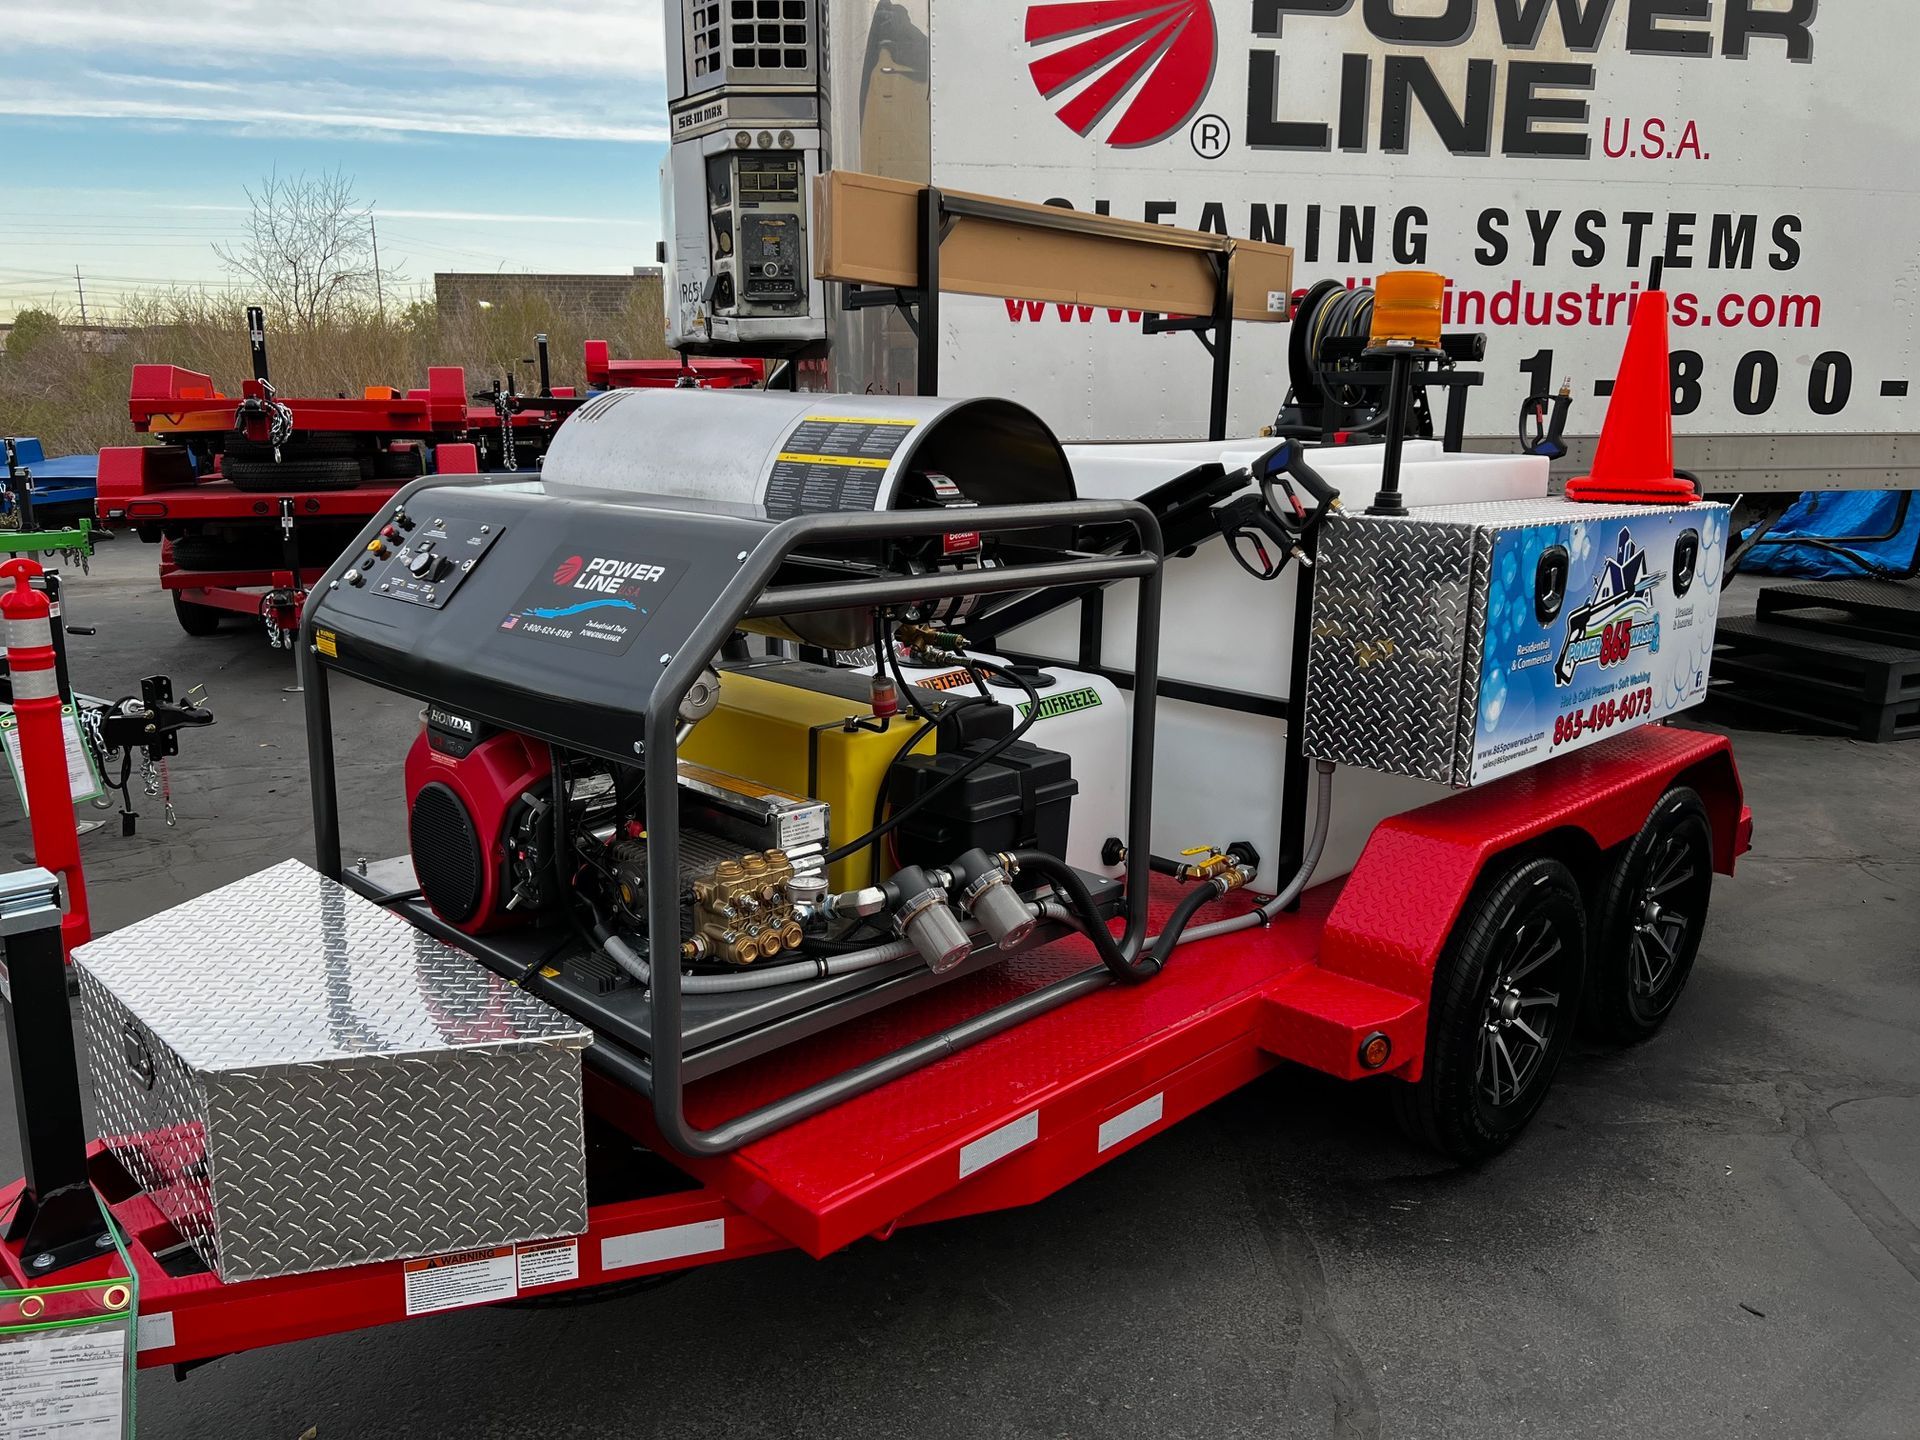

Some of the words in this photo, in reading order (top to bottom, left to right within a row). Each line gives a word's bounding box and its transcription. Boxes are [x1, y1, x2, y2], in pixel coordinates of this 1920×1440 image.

[704, 104, 722, 121] MAX
[1245, 49, 1594, 159] LINE
[1602, 117, 1711, 160] U.S.A.
[1474, 207, 1801, 271] SYSTEMS
[585, 557, 665, 582] POWER
[573, 573, 625, 594] LINE
[617, 585, 641, 597] USA
[1516, 638, 1550, 656] Residential
[1566, 637, 1601, 665] POWER
[1600, 618, 1633, 666] 865
[1630, 621, 1655, 647] WASH
[1511, 661, 1517, 671] &
[1517, 650, 1553, 670] Commercial
[430, 709, 473, 734] HONDA
[1553, 687, 1653, 746] 865-498-6073
[1477, 730, 1545, 760] www.865powerwash.com
[1482, 745, 1538, 770] sales@865powerwash.com
[441, 1250, 494, 1266] WARNING
